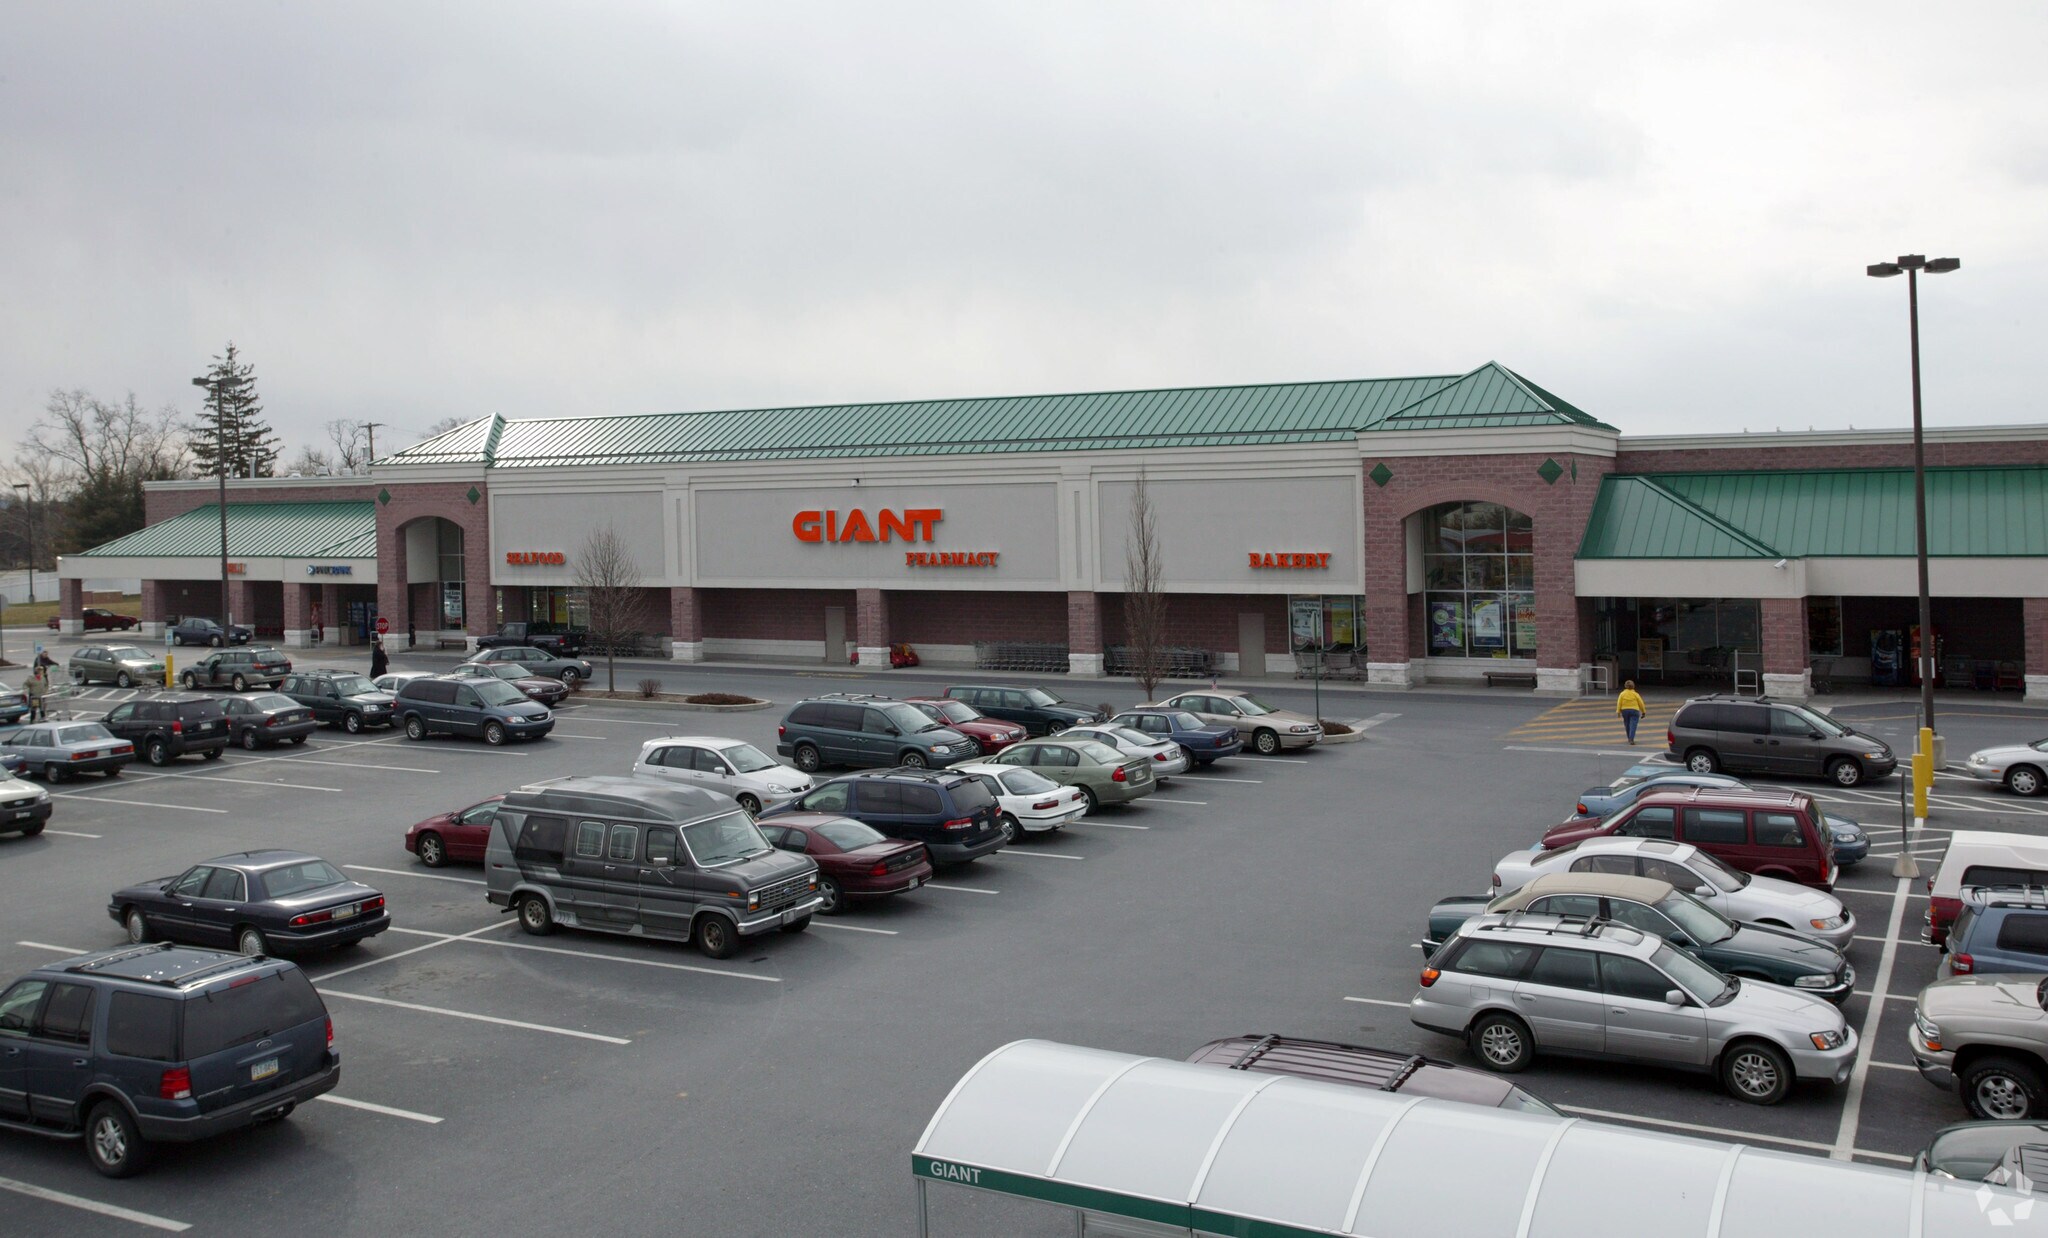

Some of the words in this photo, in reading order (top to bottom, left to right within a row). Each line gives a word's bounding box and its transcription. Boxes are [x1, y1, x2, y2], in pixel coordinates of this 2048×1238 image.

[792, 509, 943, 542] GIANT
[506, 551, 566, 565] SEAFOOD
[905, 551, 998, 567] PHARMACY
[1248, 552, 1331, 569] BAKERY
[377, 622, 389, 630] STOP
[930, 1161, 982, 1184] GIANT
